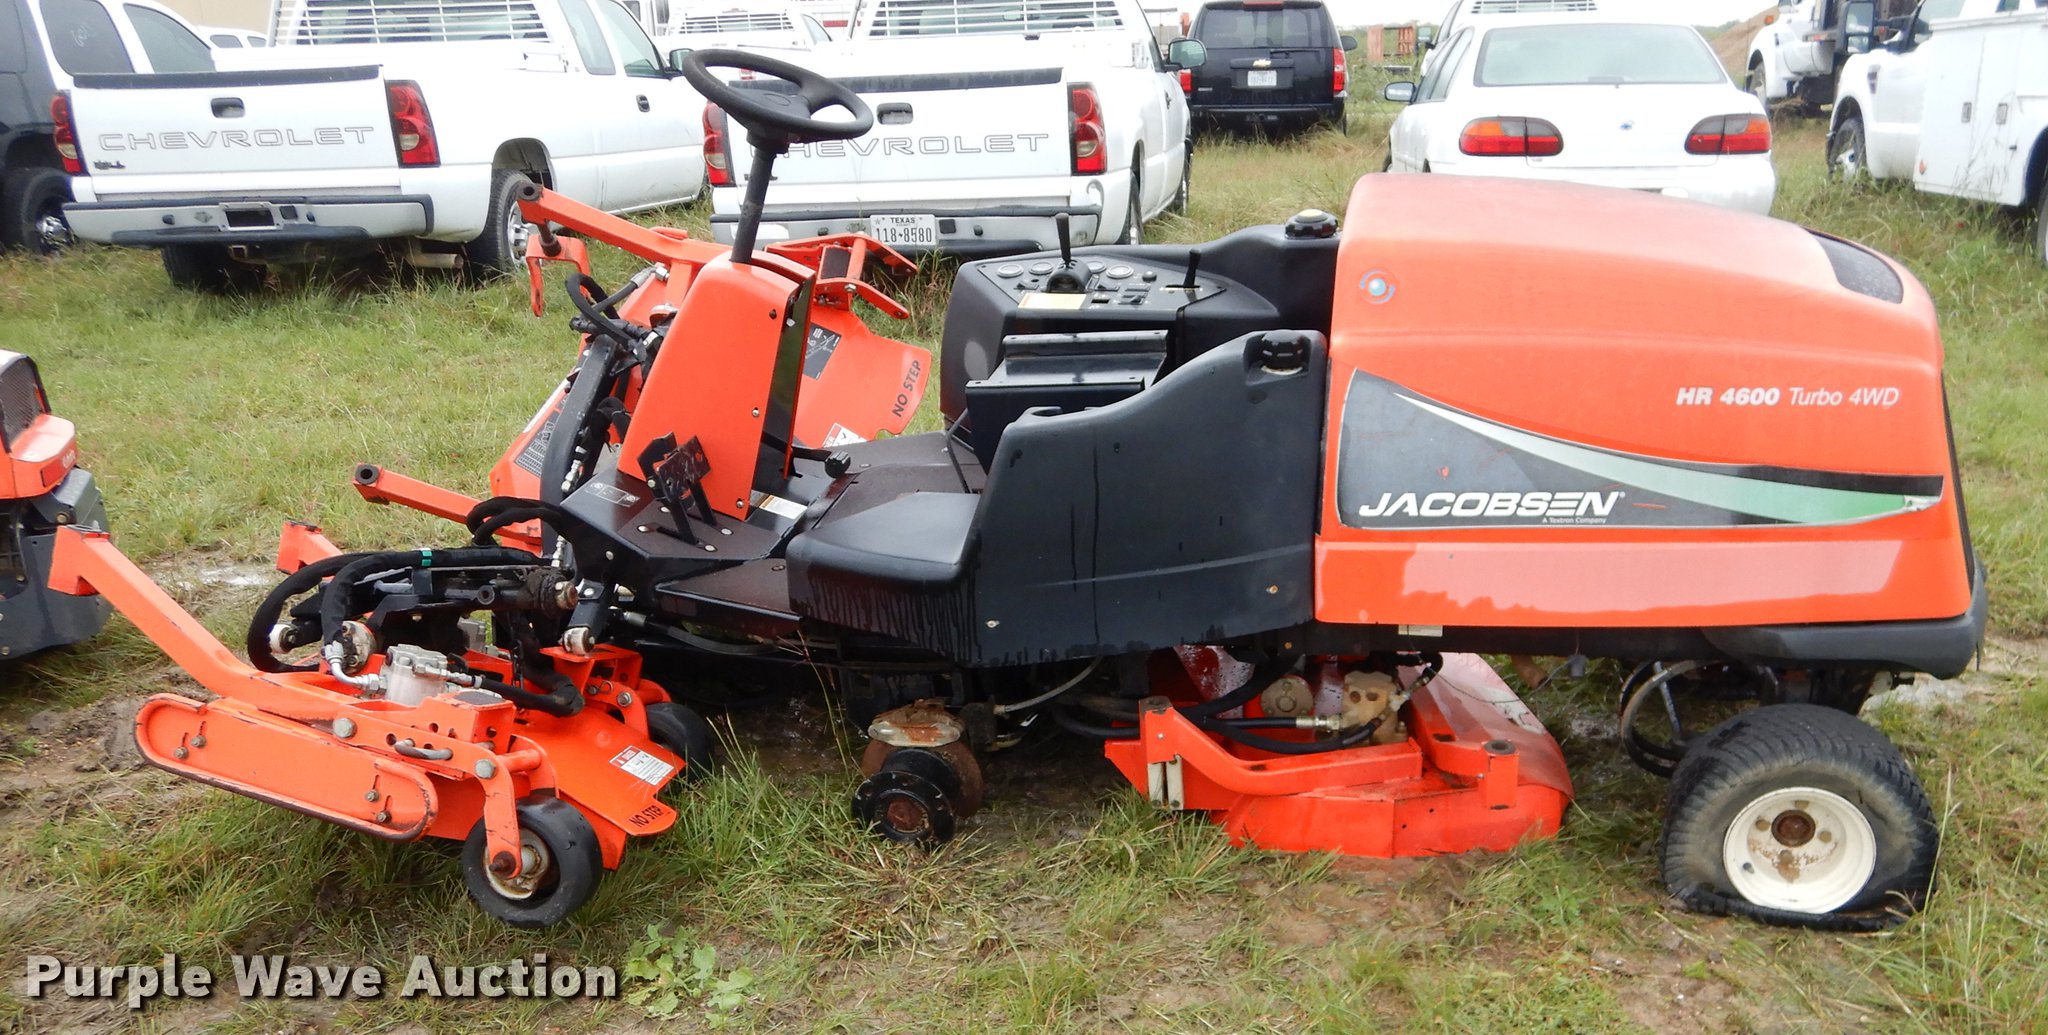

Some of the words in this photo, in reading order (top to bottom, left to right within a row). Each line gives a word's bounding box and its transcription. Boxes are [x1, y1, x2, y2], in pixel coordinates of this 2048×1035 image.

[99, 126, 374, 151] CHEVROLET
[750, 133, 1049, 158] HEVROLET
[891, 393, 909, 418] NO
[903, 359, 921, 392] STEP
[1676, 387, 1714, 406] HR
[1719, 387, 1780, 406] 4600
[1789, 387, 1843, 407] Turbo
[1849, 387, 1899, 406] 4WD
[1358, 491, 1620, 517] JACOBSEN
[1575, 517, 1607, 525] Company
[628, 814, 650, 828] NO
[641, 804, 664, 820] STEP
